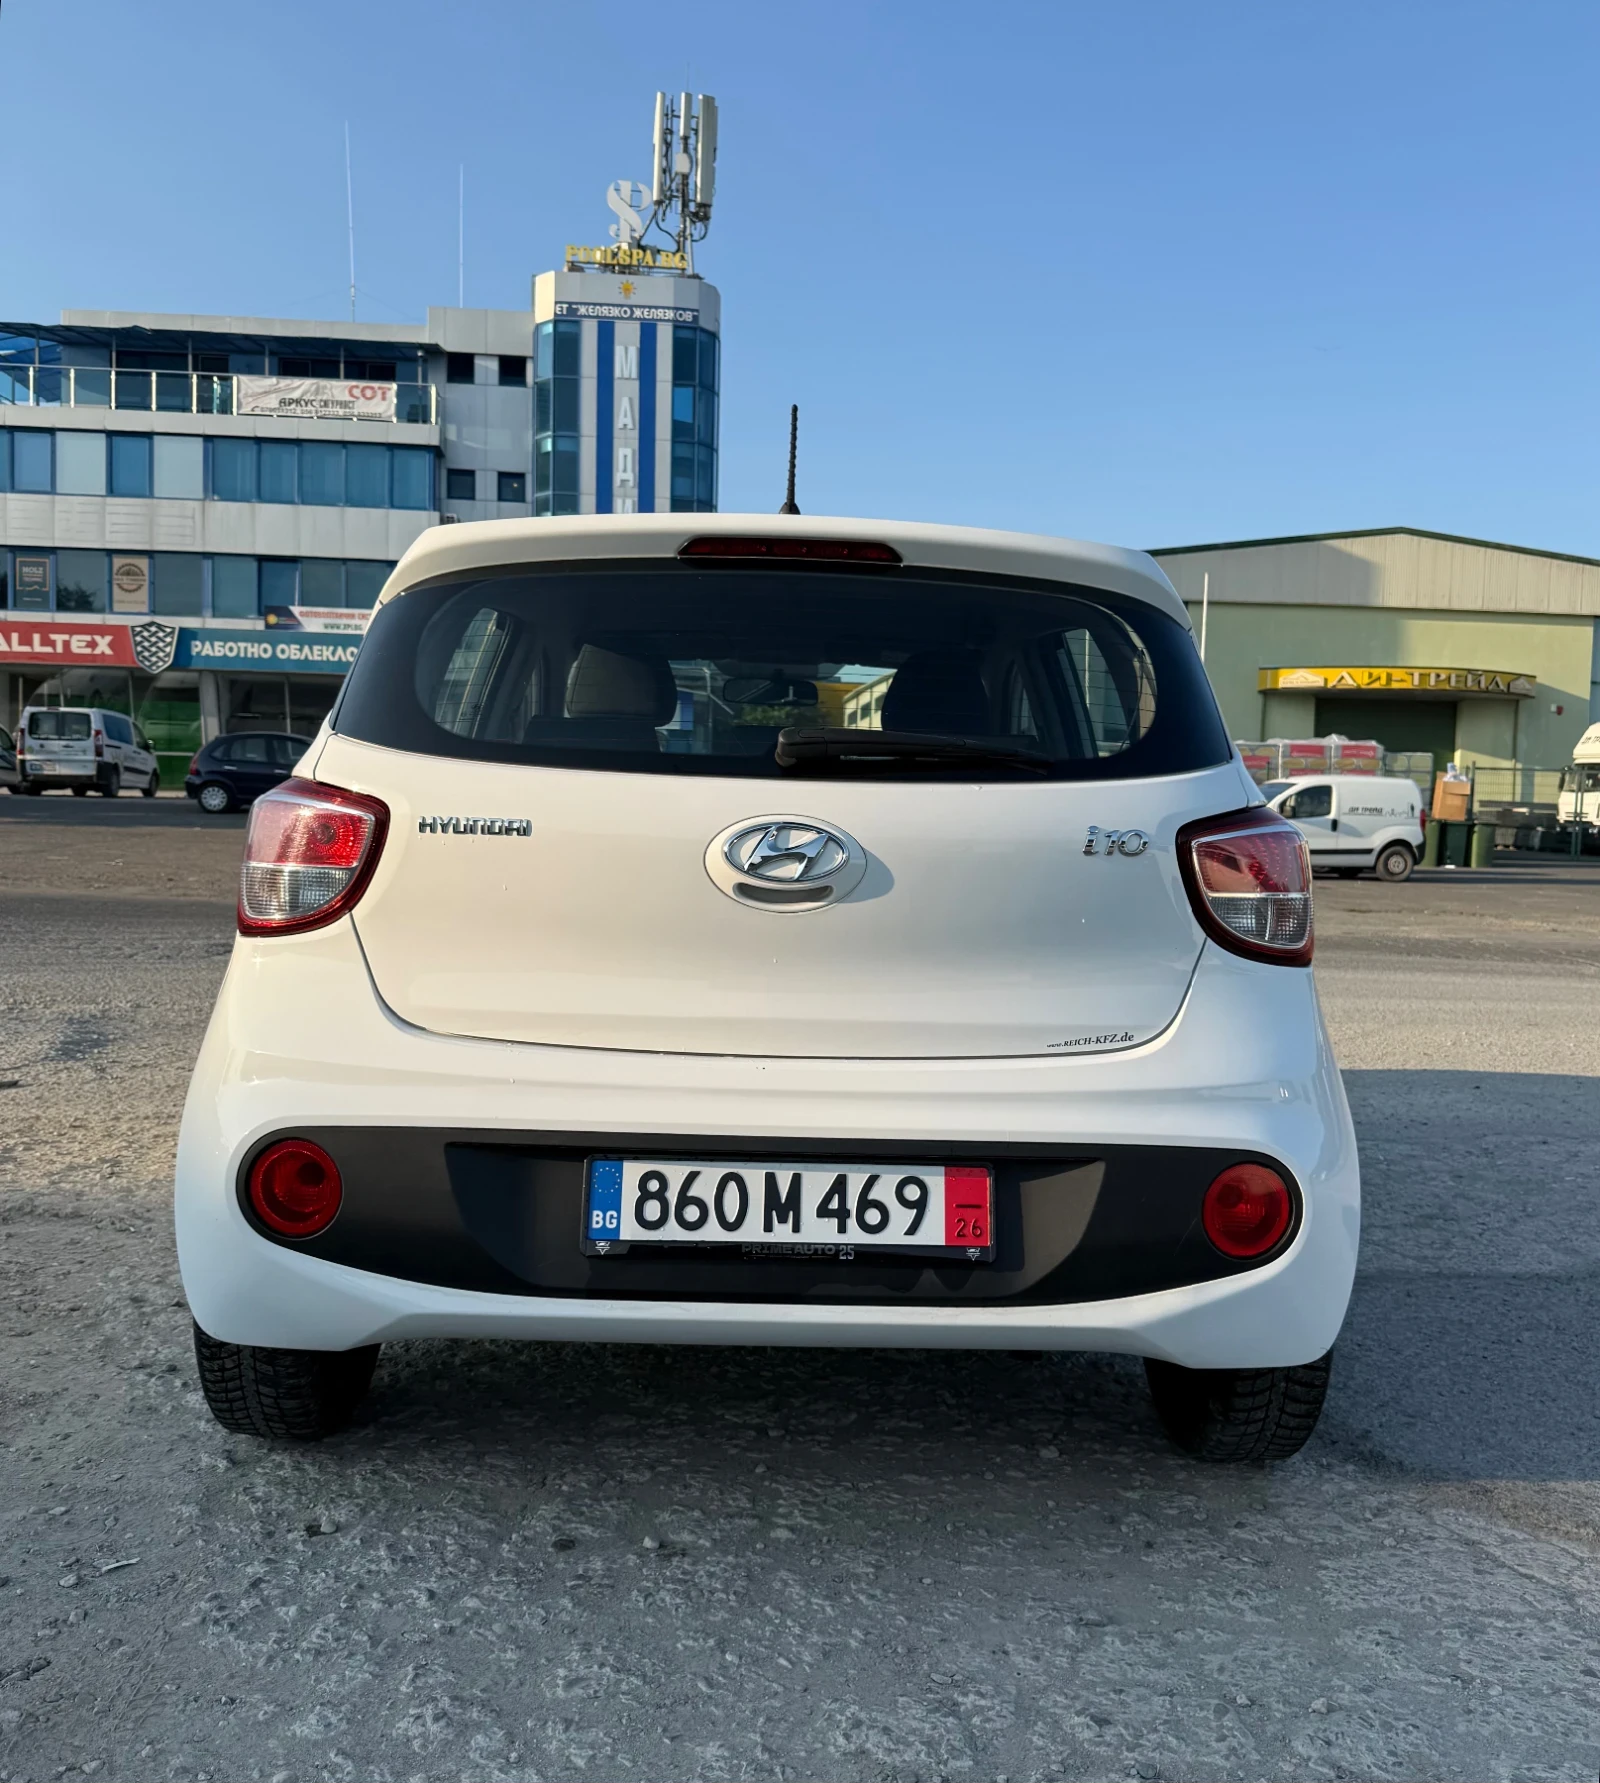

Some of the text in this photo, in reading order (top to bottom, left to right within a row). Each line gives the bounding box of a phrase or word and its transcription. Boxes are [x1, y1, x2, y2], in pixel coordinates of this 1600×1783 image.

[565, 244, 688, 269] POOLSPA.BG
[555, 303, 569, 315] ЕТ
[279, 397, 317, 408] АРКУС
[348, 384, 391, 401] СОТ
[191, 640, 358, 662] РАБОТНО ОБЛЕКЛО
[418, 815, 533, 837] HYUNDAI
[1082, 825, 1149, 857] i10
[1046, 1031, 1135, 1048] www.REICH-KFZ.de
[634, 1169, 929, 1236] 860 M 469
[591, 1209, 618, 1229] BG
[954, 1217, 983, 1238] 26
[839, 1244, 855, 1260] 25
